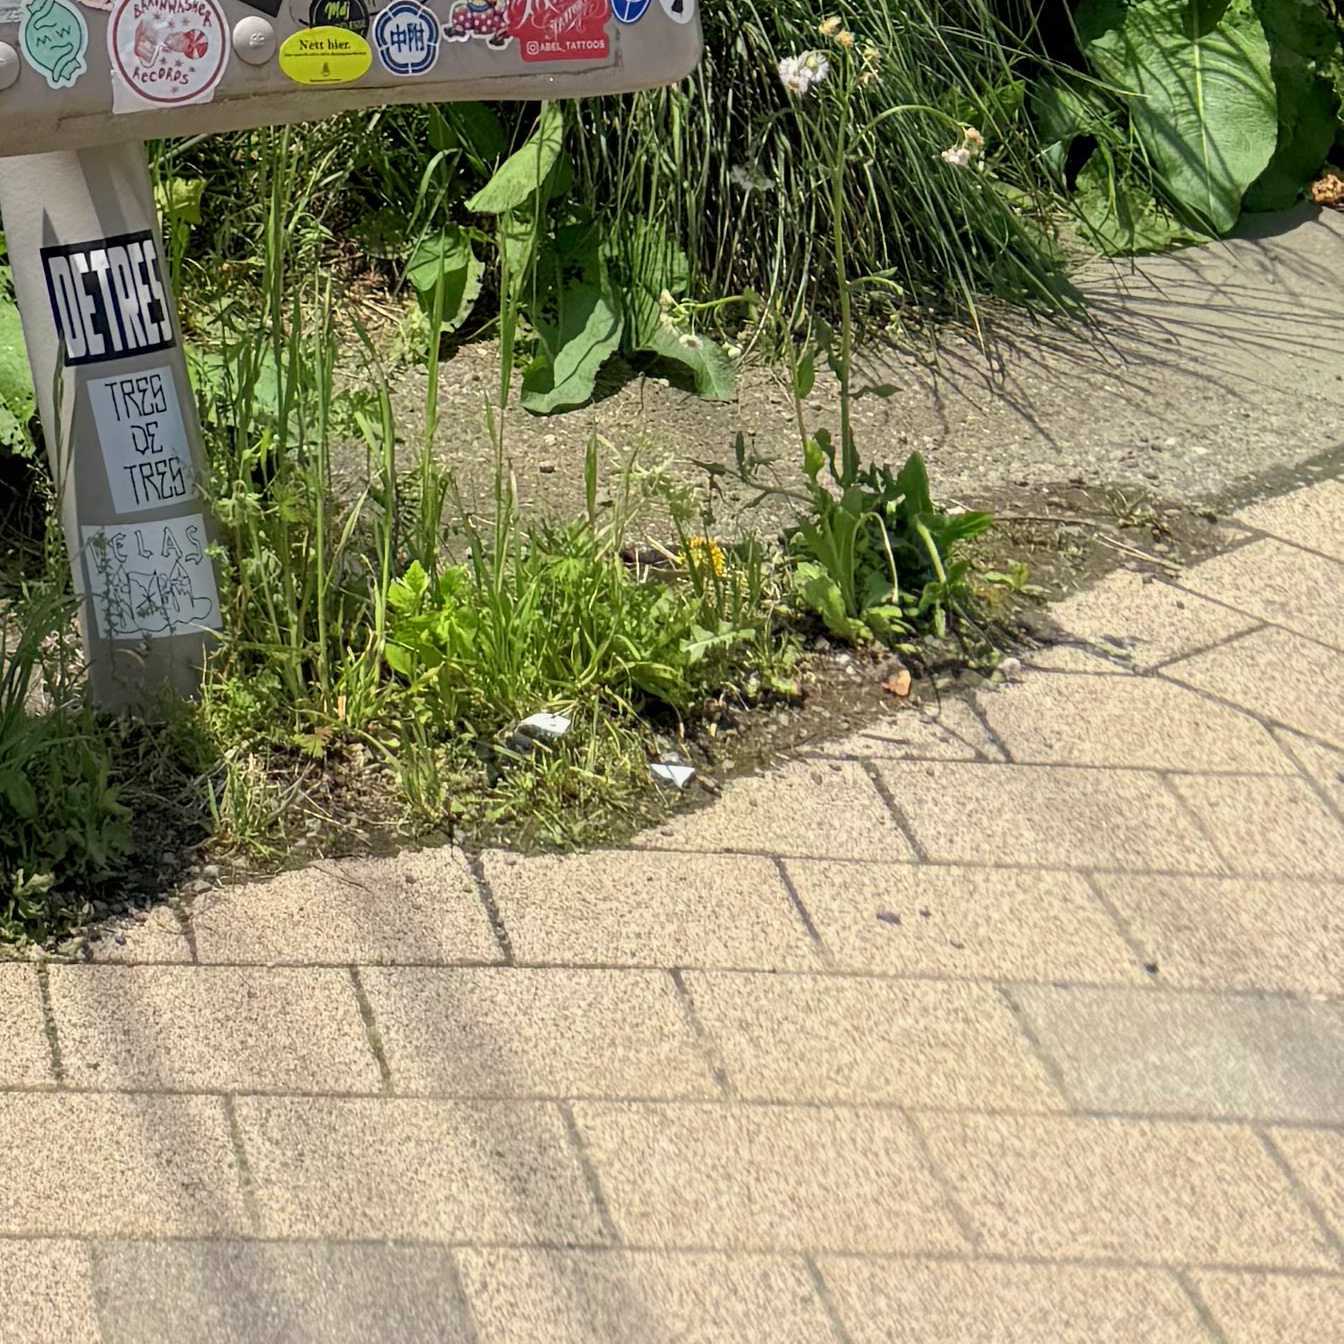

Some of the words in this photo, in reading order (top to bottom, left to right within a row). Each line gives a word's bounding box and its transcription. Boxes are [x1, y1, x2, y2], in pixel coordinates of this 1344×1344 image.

[299, 38, 326, 51] Nett
[47, 238, 173, 359] DETRES
[104, 373, 168, 422] TRES
[130, 420, 164, 456] DE
[123, 455, 186, 505] TRES
